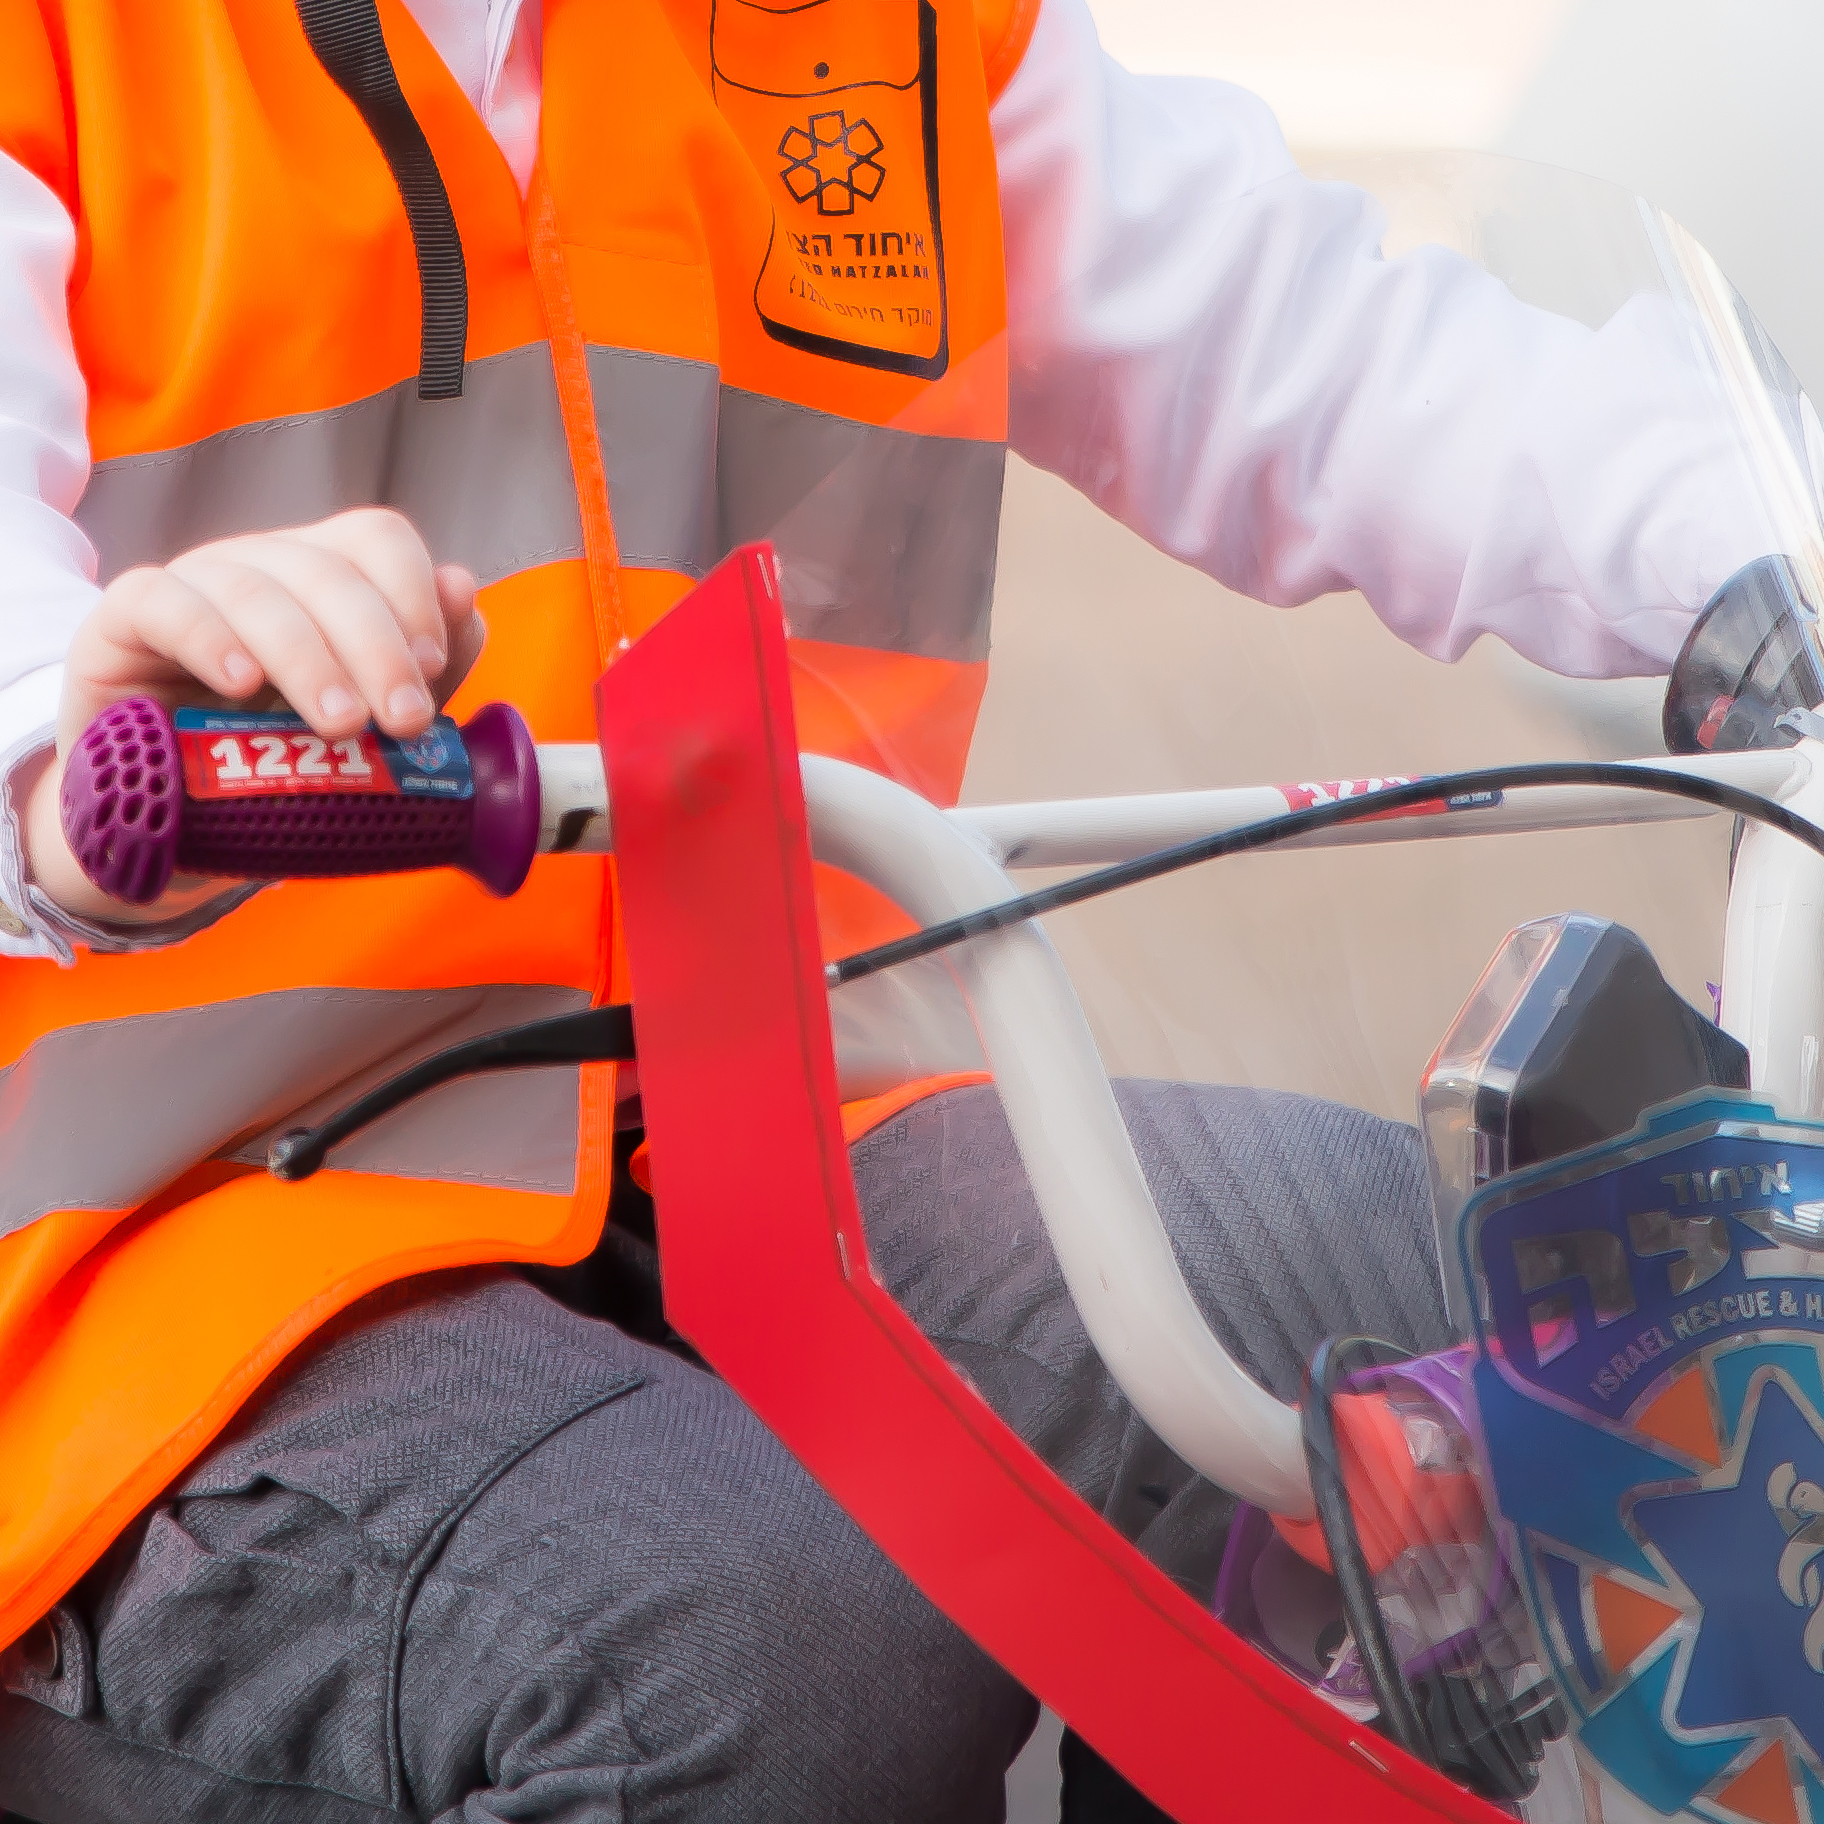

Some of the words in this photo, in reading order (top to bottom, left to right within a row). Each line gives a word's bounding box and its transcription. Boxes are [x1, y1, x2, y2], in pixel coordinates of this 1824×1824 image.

[785, 230, 832, 257] הצ
[843, 231, 927, 258] איחוד
[210, 736, 373, 779] 1221
[1661, 1160, 1793, 1207] איחוד
[1588, 1325, 1676, 1402] ISRAEL
[1669, 1288, 1775, 1341] RESCUE
[1779, 1286, 1799, 1318] &
